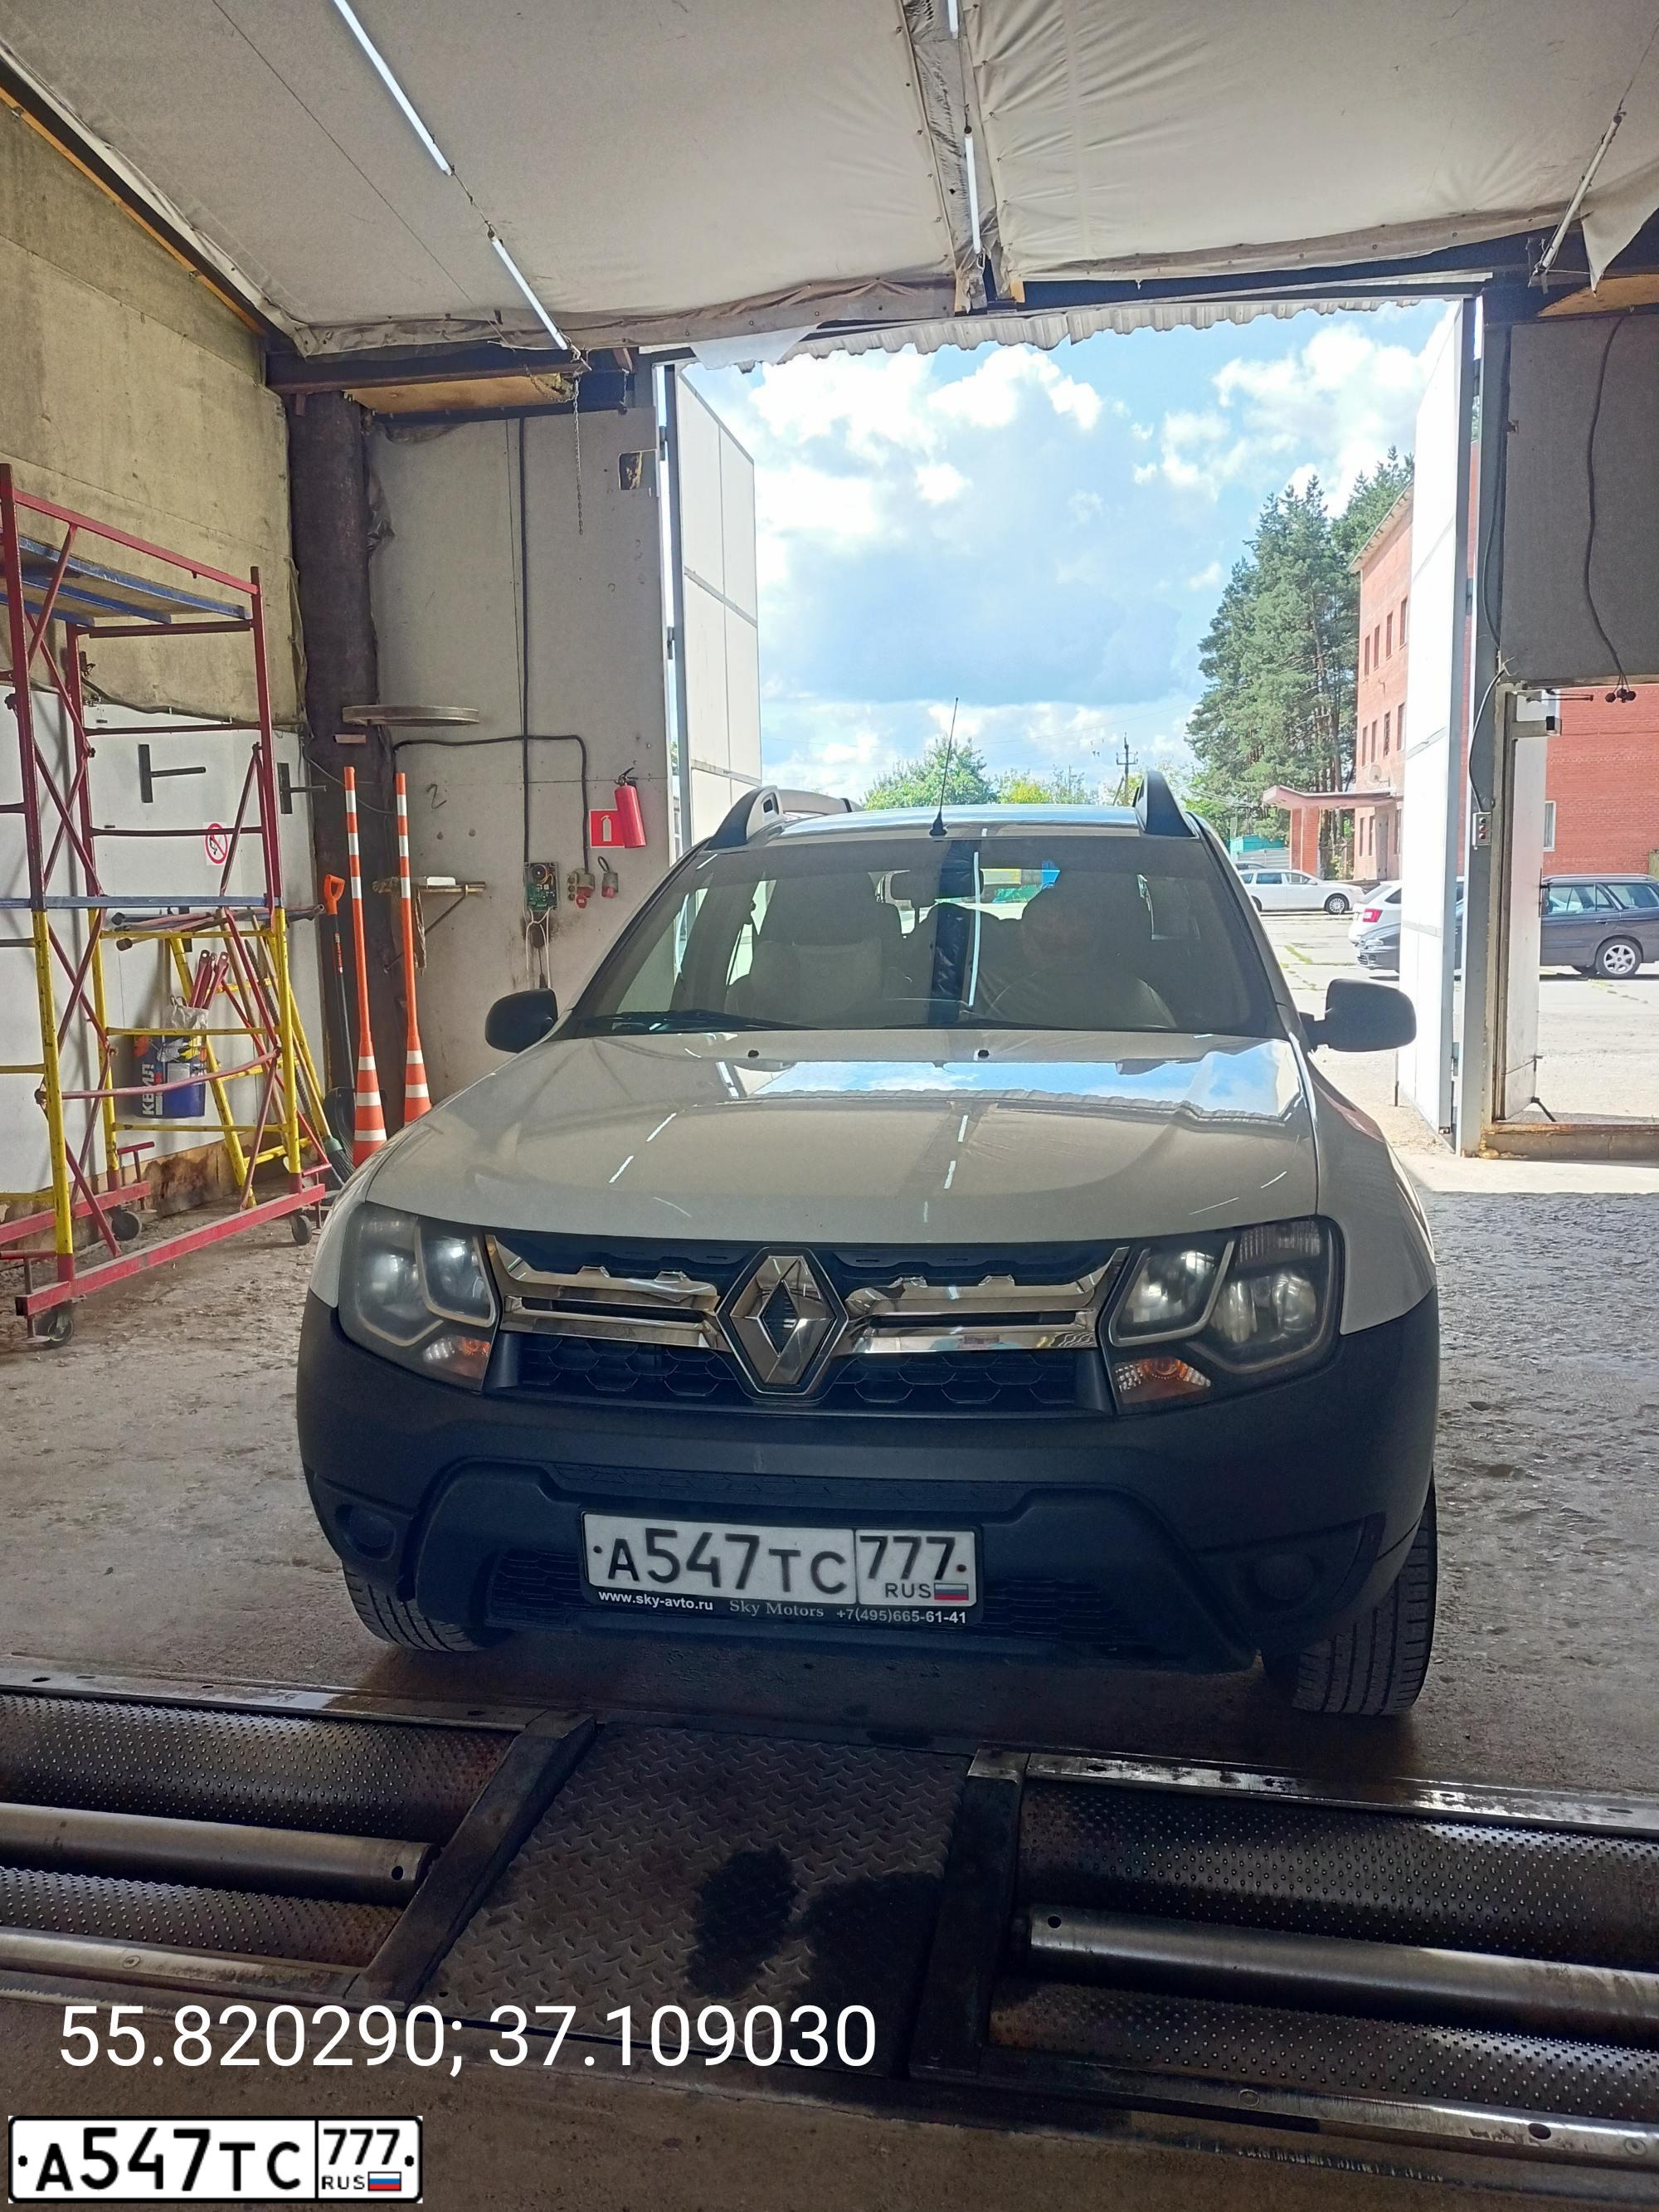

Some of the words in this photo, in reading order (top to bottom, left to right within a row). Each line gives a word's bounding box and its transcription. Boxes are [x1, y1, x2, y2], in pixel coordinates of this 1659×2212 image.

[859, 1536, 956, 1581] 777
[884, 1582, 932, 1600] RUS
[598, 1591, 714, 1611] www.sky-avto.ru
[729, 1600, 761, 1617] Sky
[766, 1602, 825, 1618] Motors
[836, 1608, 968, 1625] +7(495)665-61-41
